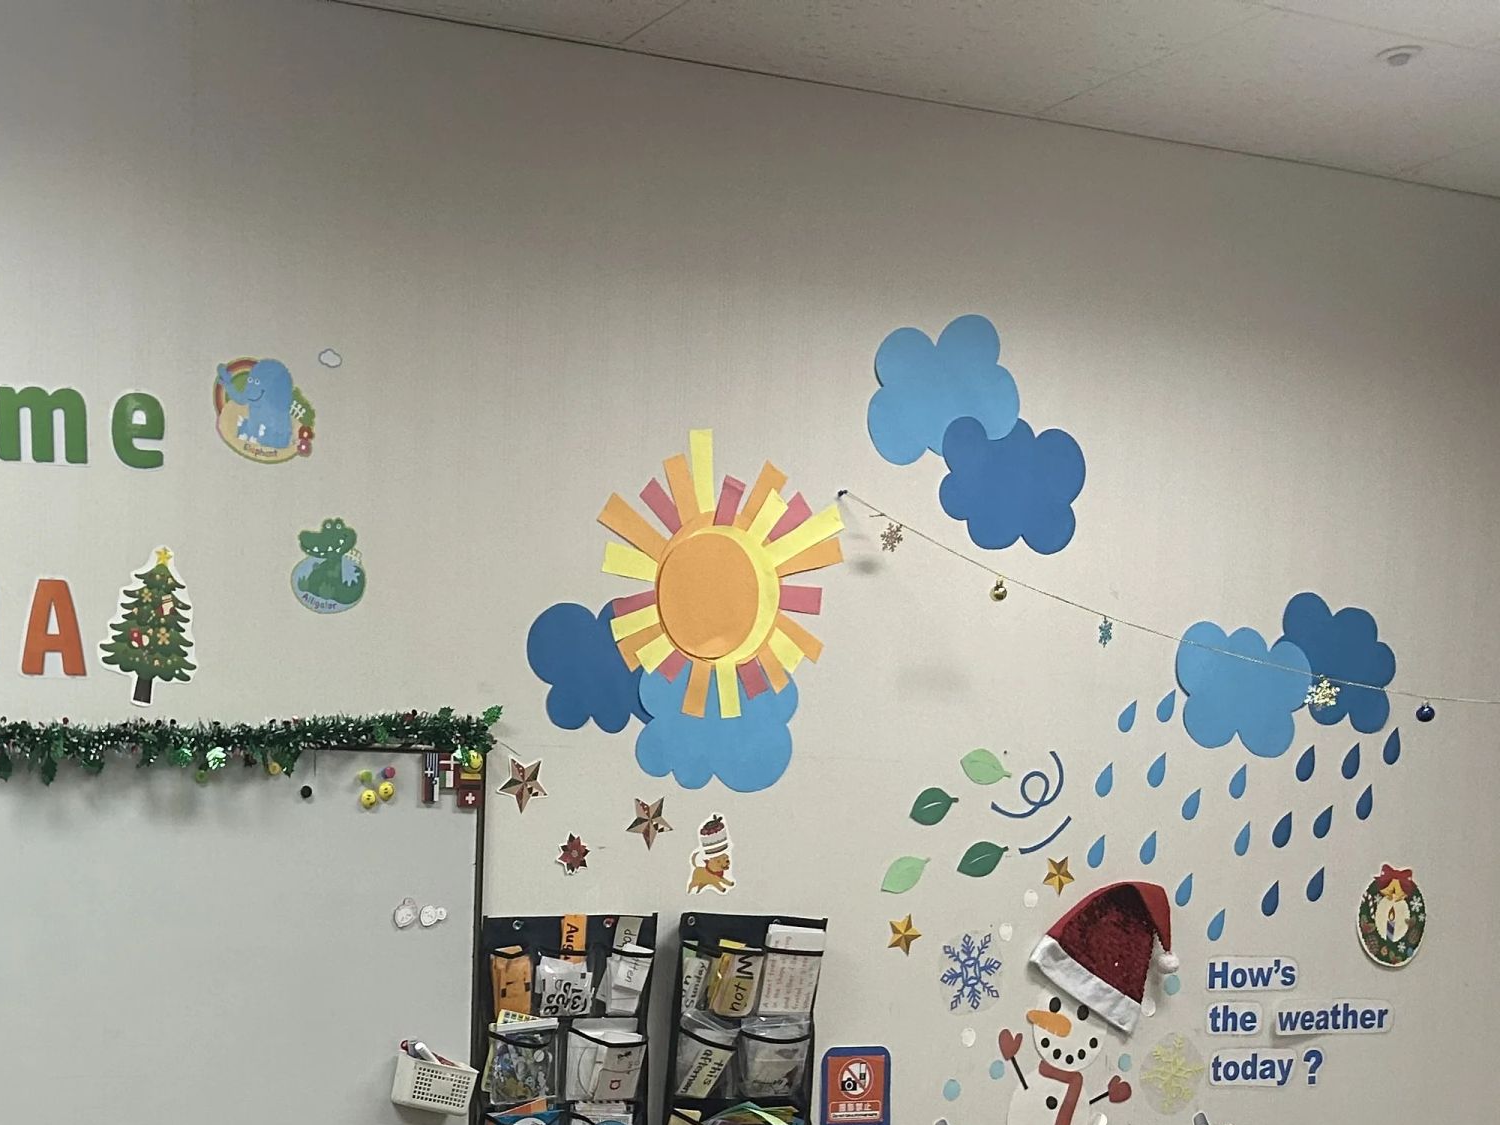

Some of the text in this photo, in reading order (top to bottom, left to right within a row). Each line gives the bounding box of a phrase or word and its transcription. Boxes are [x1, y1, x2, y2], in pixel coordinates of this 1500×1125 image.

[1207, 959, 1296, 989] How's
[1208, 1003, 1389, 1032] the weather
